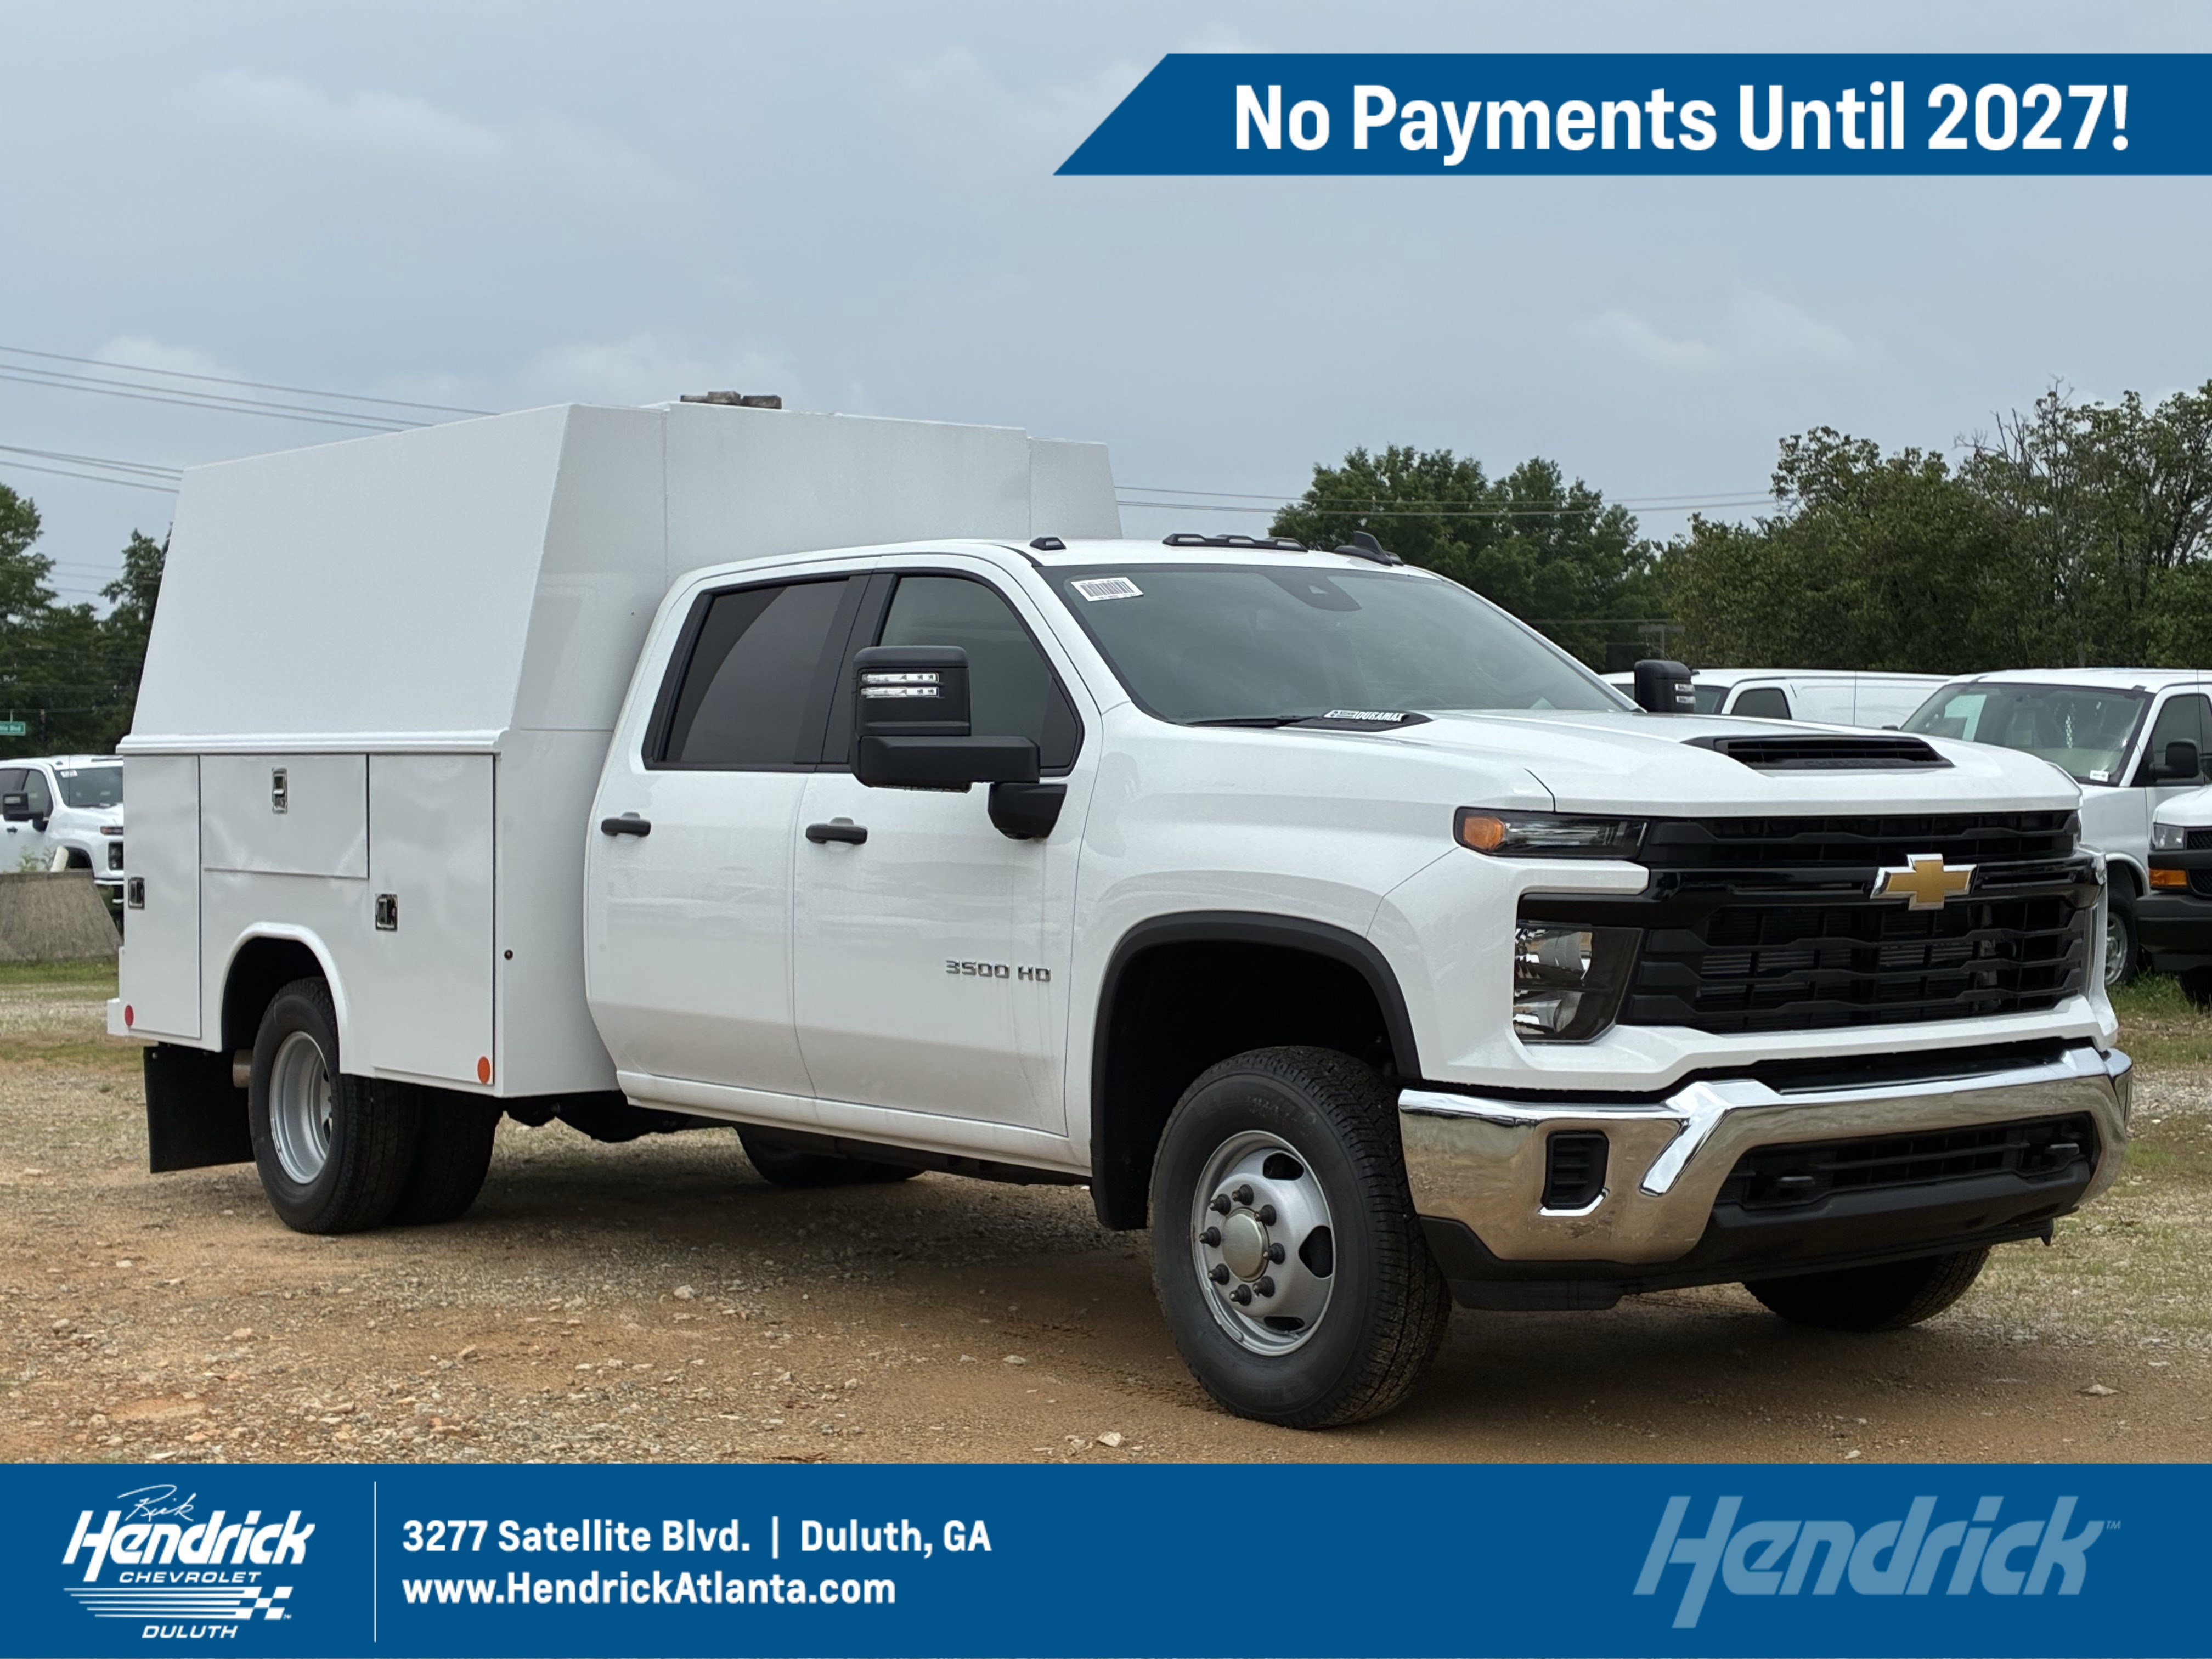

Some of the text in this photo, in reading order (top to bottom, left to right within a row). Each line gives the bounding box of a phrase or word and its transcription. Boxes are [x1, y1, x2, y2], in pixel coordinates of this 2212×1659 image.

[1355, 711, 1406, 723] DURAMAX
[945, 960, 1051, 983] 3500 HD
